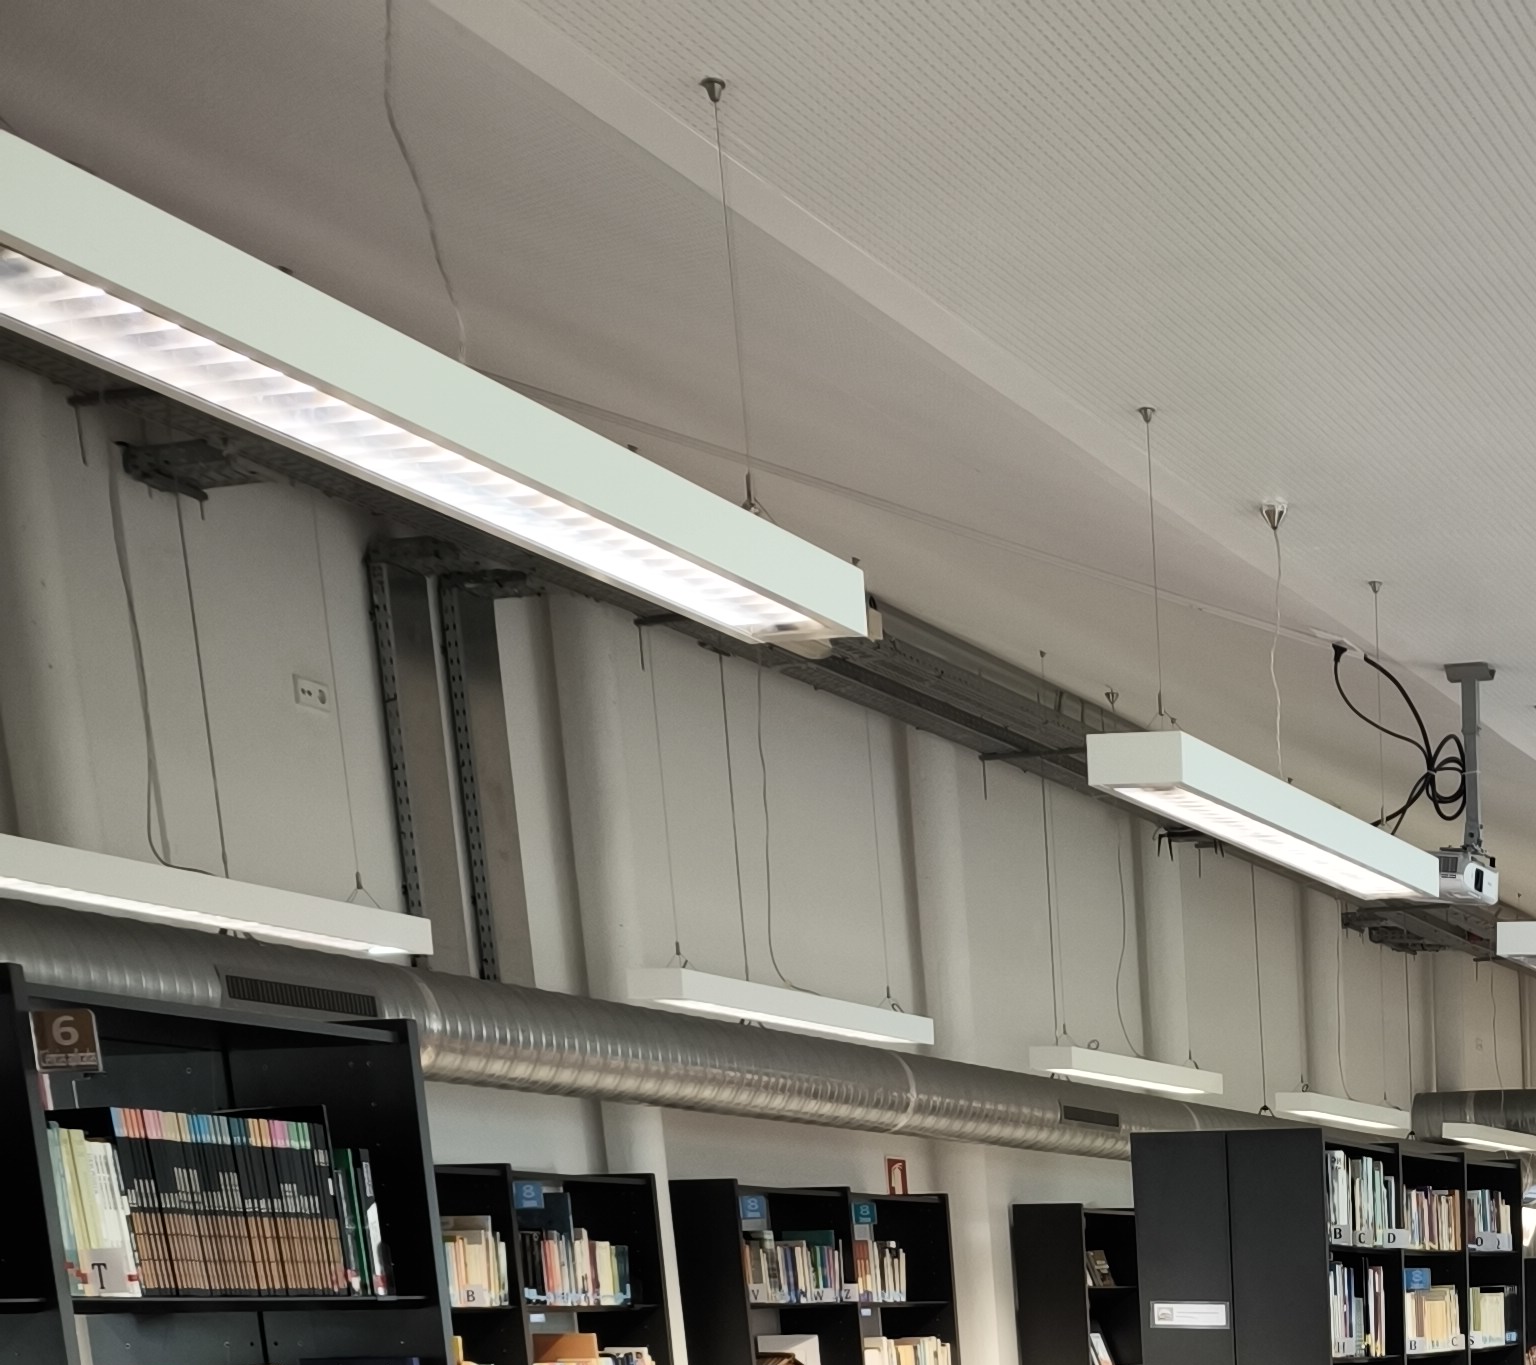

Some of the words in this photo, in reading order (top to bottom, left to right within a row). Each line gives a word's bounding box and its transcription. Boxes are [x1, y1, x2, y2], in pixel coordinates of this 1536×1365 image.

[51, 1014, 80, 1047] 6
[522, 1184, 536, 1199] 8
[747, 1198, 759, 1210] 8
[859, 1204, 870, 1216] 8
[1333, 1227, 1343, 1240] B
[1357, 1232, 1366, 1244] C
[1387, 1232, 1397, 1244] D
[91, 1262, 107, 1290] T
[466, 1289, 476, 1302] B
[751, 1288, 760, 1300] V
[813, 1290, 825, 1301] W
[843, 1288, 852, 1300] Z
[1409, 1339, 1417, 1351] B
